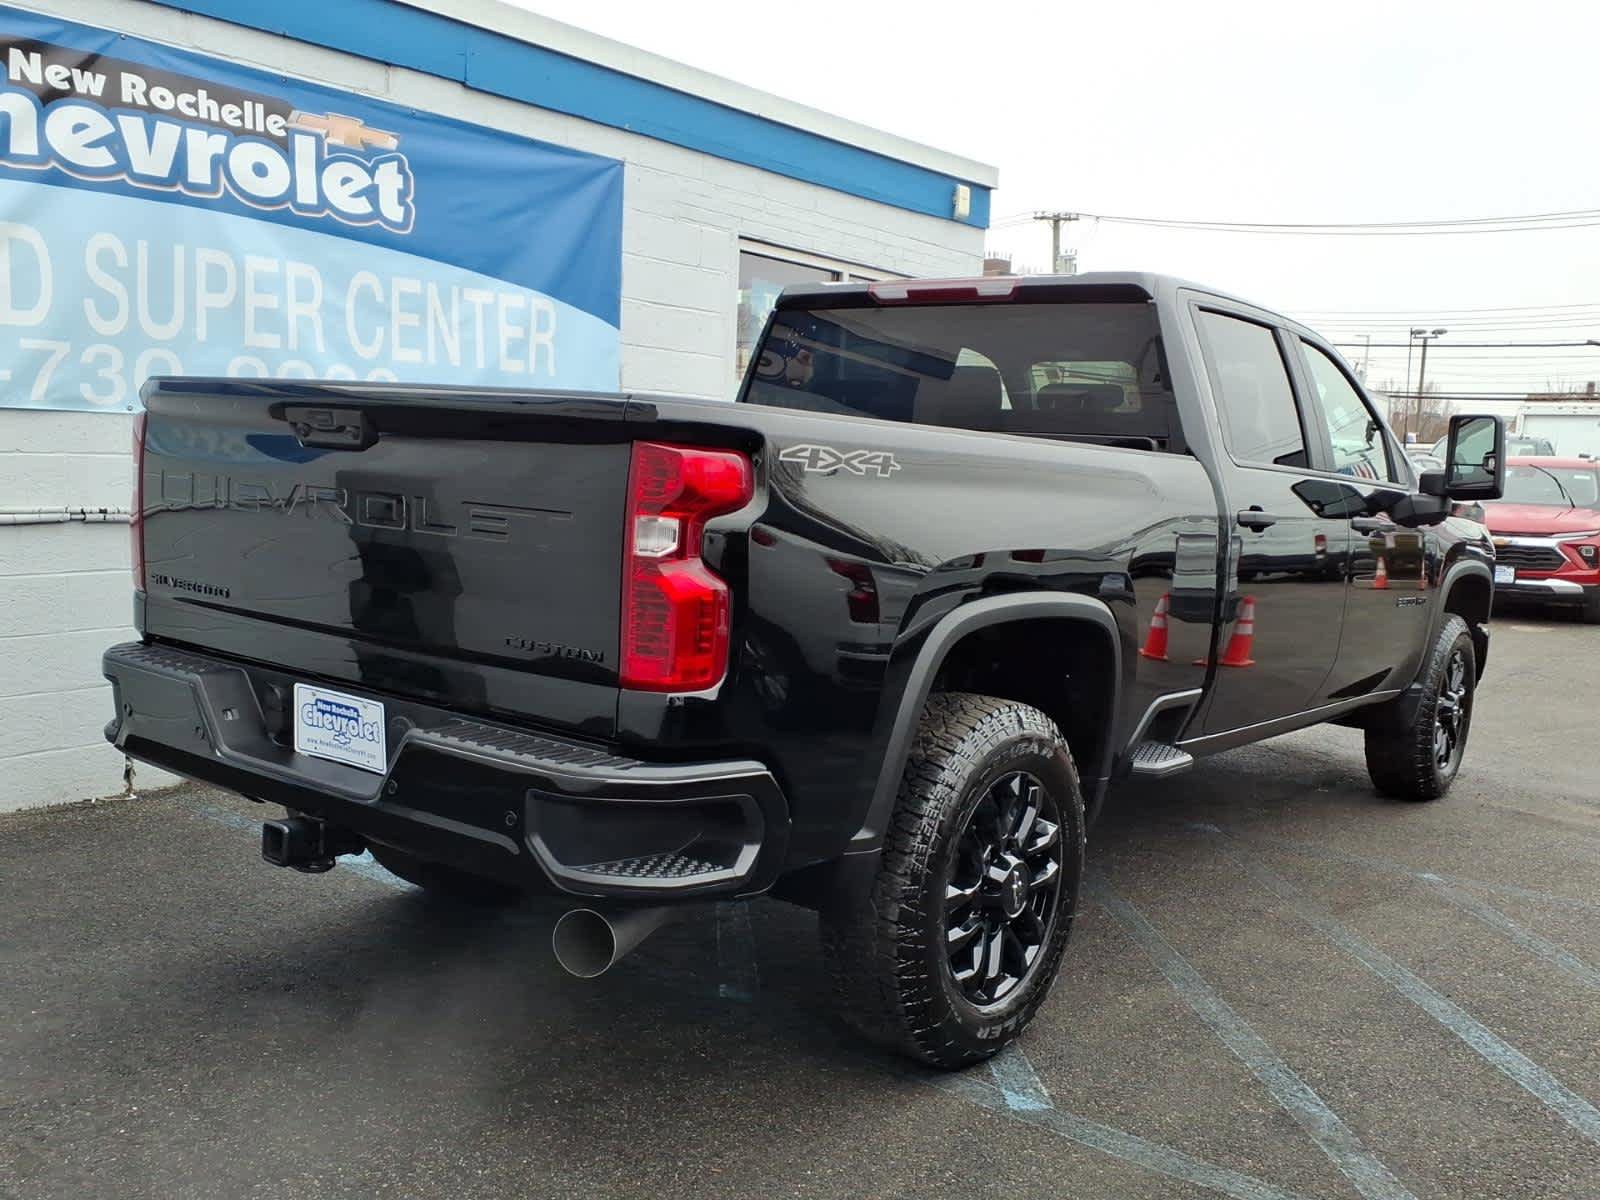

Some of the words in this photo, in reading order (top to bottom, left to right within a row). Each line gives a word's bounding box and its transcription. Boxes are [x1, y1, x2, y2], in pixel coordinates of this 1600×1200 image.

[9, 47, 107, 97] New
[120, 71, 289, 137] Rochelle
[83, 231, 326, 353] SUPER
[345, 271, 558, 377] CENTER
[302, 703, 380, 744] Chevrolet
